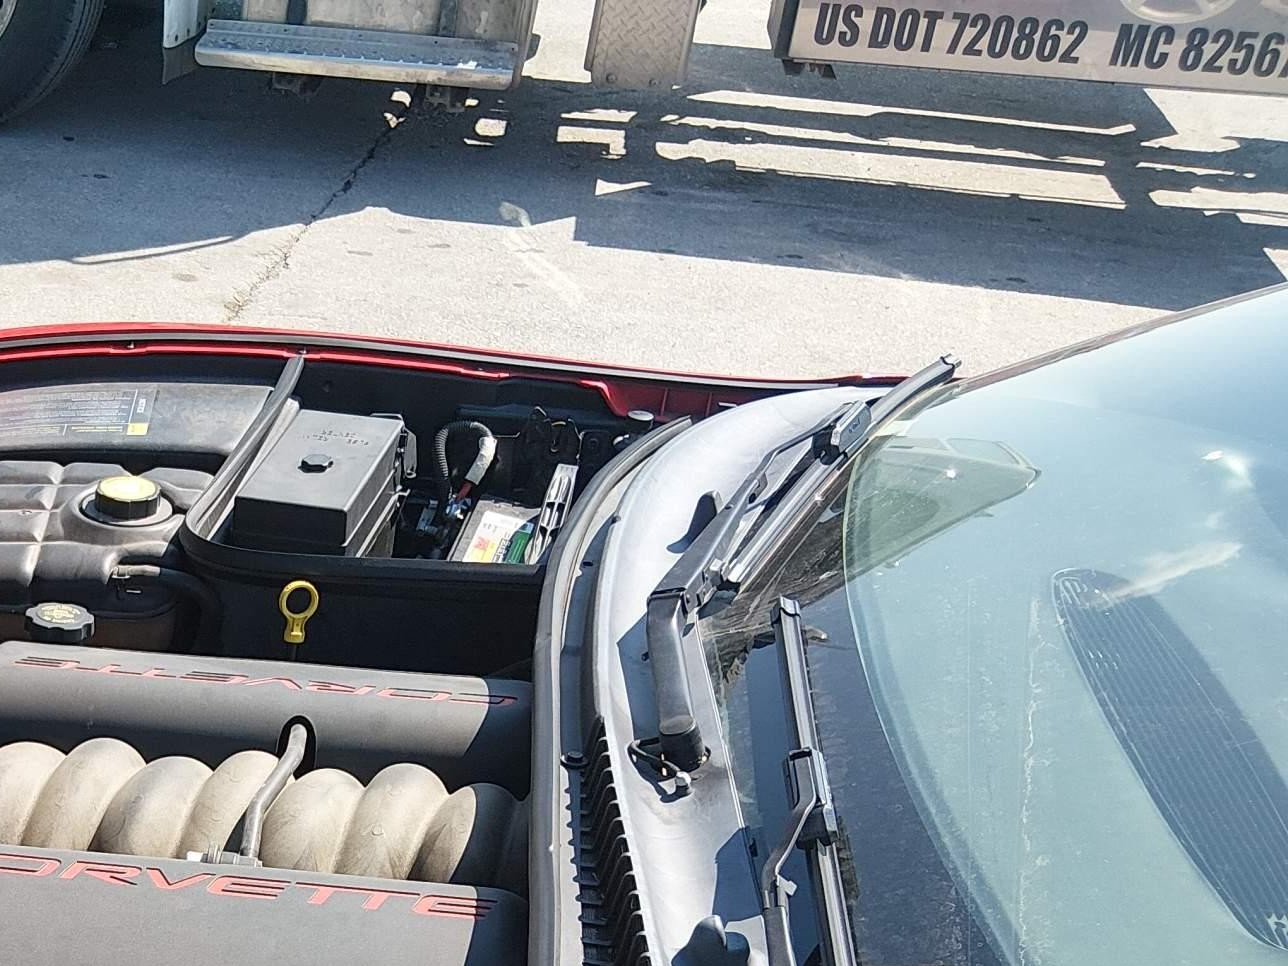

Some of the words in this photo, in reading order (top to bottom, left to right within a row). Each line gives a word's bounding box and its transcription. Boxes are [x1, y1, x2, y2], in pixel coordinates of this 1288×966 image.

[814, 2, 863, 47] US
[867, 5, 944, 53] DOT
[946, 12, 1089, 65] 720862
[1109, 22, 1175, 70] MC
[1178, 27, 1288, 78] 8256
[14, 656, 518, 706] CORVETTE
